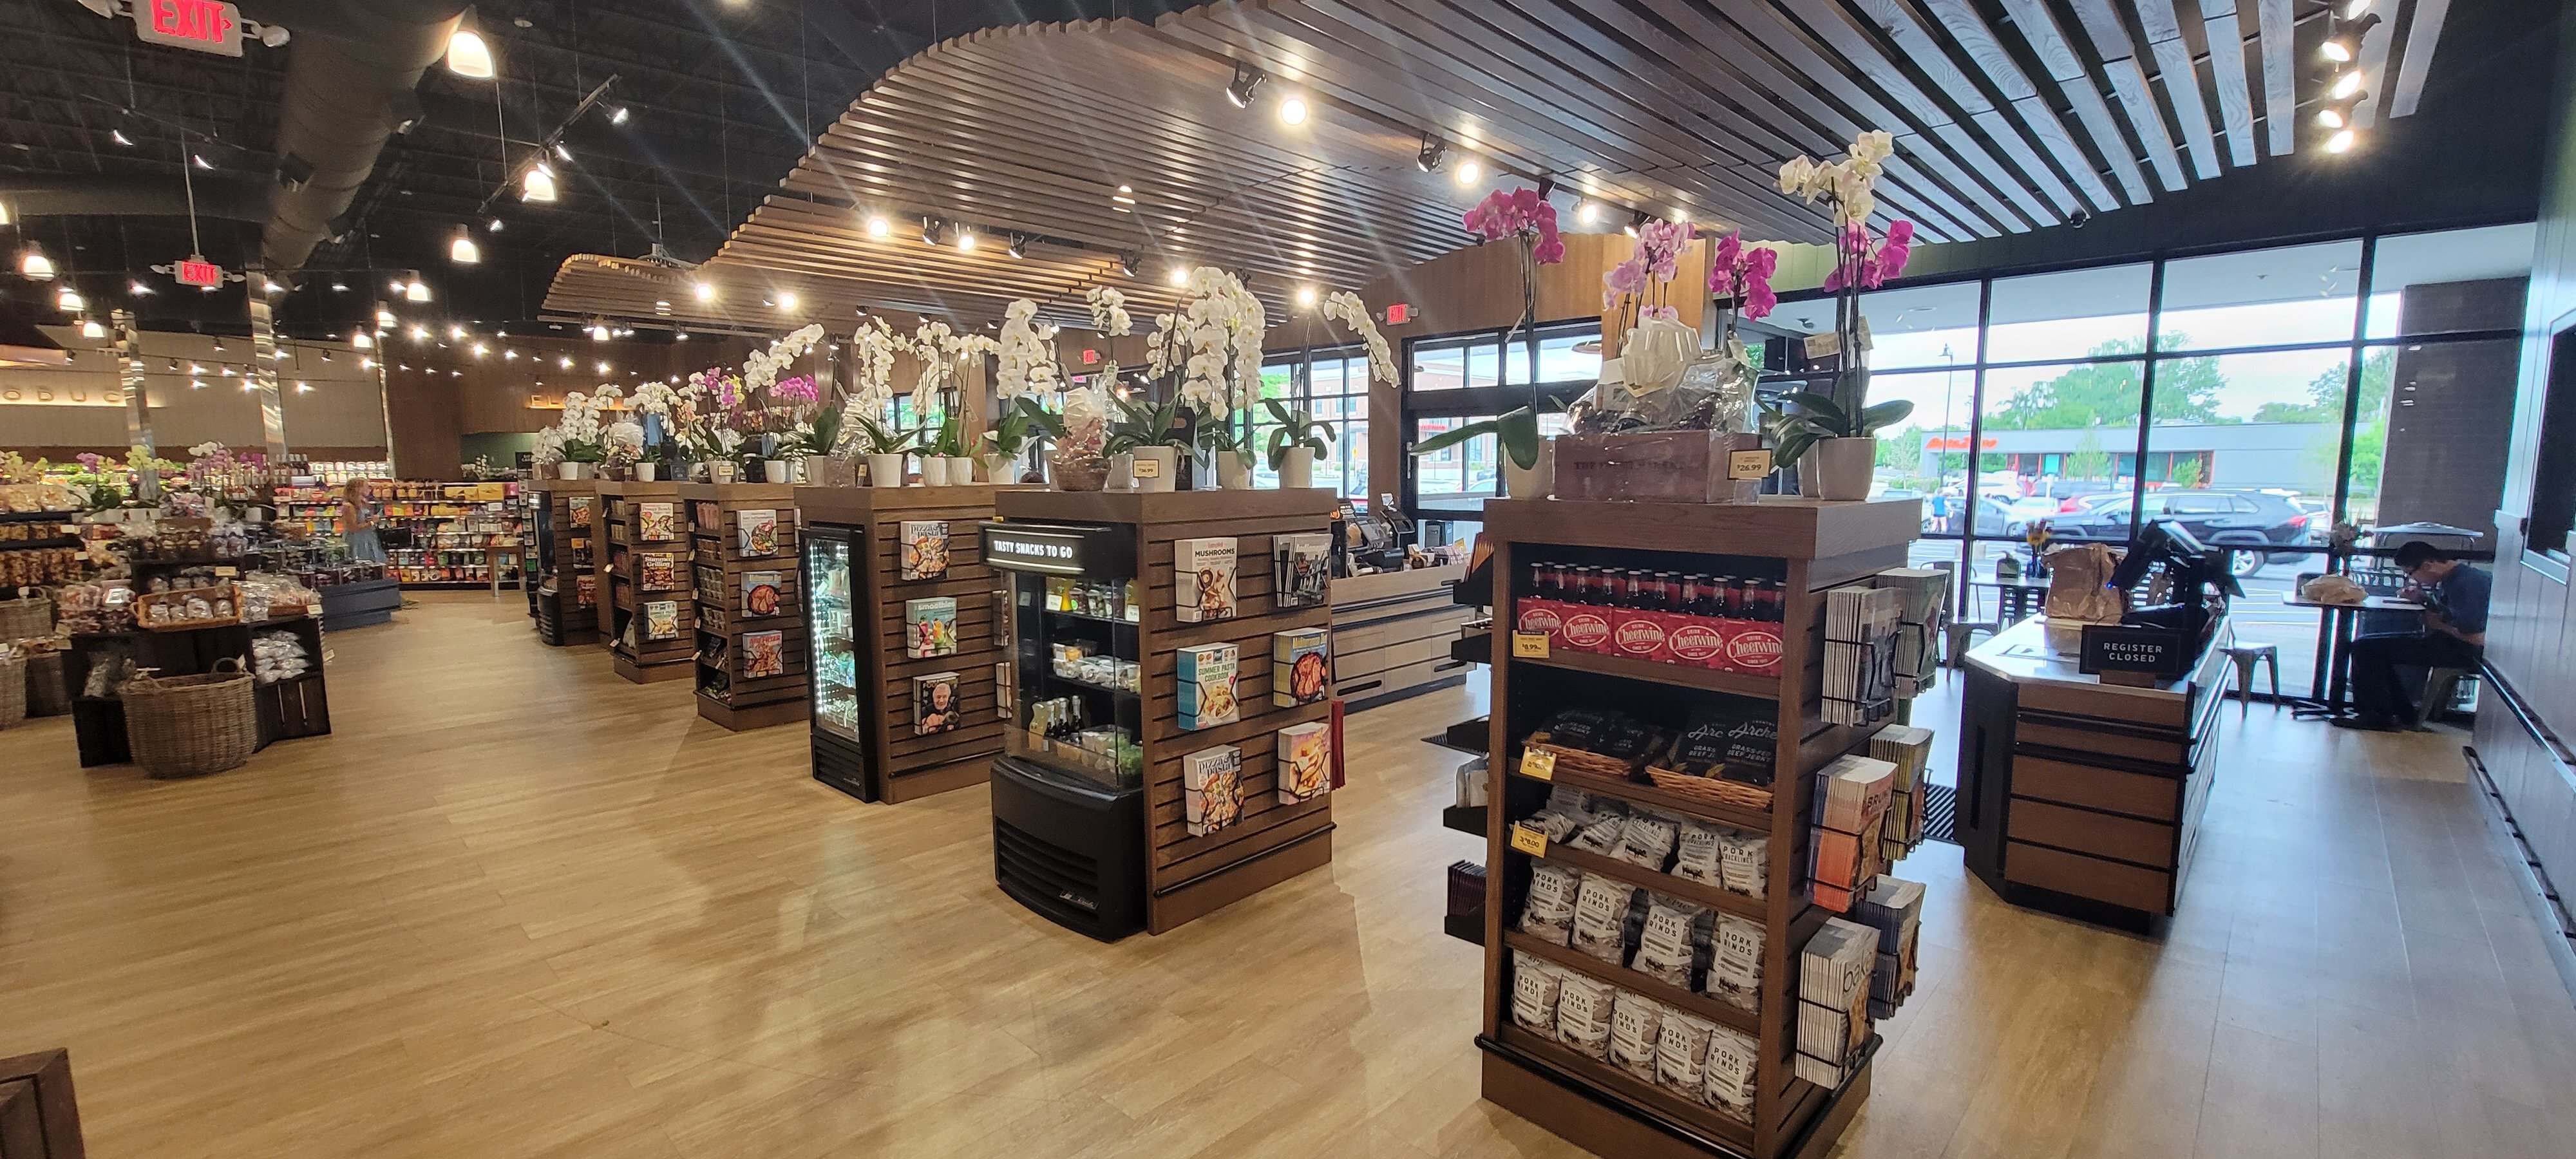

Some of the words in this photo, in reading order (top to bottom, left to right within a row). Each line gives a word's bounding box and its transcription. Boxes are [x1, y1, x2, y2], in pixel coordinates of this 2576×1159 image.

[150, 0, 224, 43] EXIT
[183, 262, 215, 285] EXIT
[1925, 437, 1998, 449] AutoZne
[994, 540, 1014, 553] TASTY
[1015, 542, 1045, 556] SNACKS
[1045, 545, 1057, 558] TO
[1059, 546, 1073, 558] GO
[1195, 548, 1235, 558] MUSHROOMS
[1519, 614, 1562, 631] Cheerwine
[1563, 620, 1609, 639] Cheerwine
[1615, 627, 1665, 646] Cheerwine
[1669, 632, 1723, 652] Cheerwine
[2103, 643, 2163, 653] REGISTER
[2108, 652, 2155, 663] CLOSED
[1198, 666, 1220, 675] SUMMER
[1222, 663, 1235, 672] PASTA
[1745, 753, 1772, 762] JERKY
[1723, 845, 1753, 857] PORK
[1535, 872, 1558, 885] PORK
[1582, 895, 1610, 912] RINDS
[1586, 889, 1609, 903] PORK
[1649, 919, 1677, 938] RINDS
[1653, 913, 1676, 928] PORK
[1723, 939, 1752, 956] RINDS
[1725, 931, 1752, 947] PORK
[1519, 975, 1539, 990] PORK
[1562, 996, 1588, 1013] RINDS
[1564, 989, 1586, 1005] PORK
[1613, 1008, 1635, 1025] PORK
[1613, 1016, 1637, 1034] INDS
[1662, 1026, 1686, 1042] PORK
[1710, 1053, 1740, 1075] RINDS
[1714, 1047, 1739, 1066] PORK
